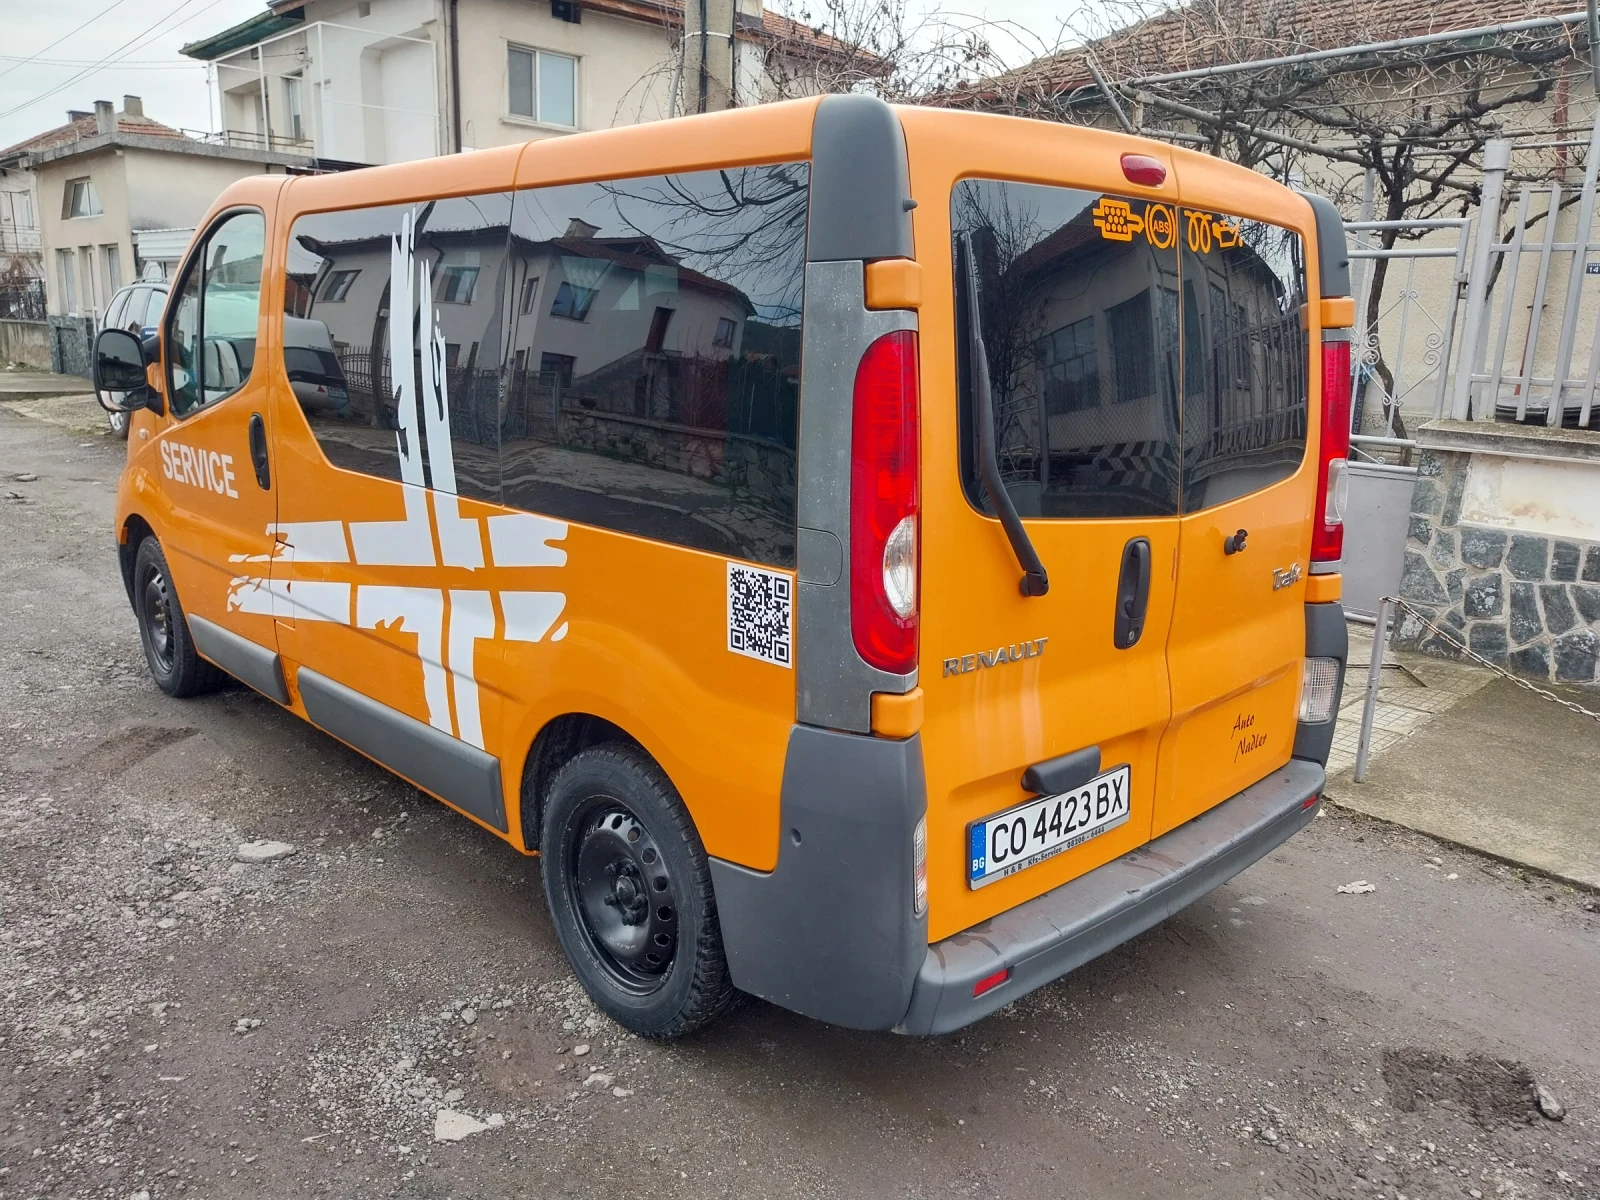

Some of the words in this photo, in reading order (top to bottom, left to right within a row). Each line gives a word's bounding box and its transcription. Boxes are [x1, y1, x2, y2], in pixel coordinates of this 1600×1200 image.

[1153, 220, 1169, 234] ABS
[160, 439, 239, 499] SERVICE
[942, 637, 1049, 678] RENAULT
[1230, 713, 1255, 740] Auto
[1233, 733, 1268, 764] Nadler
[991, 817, 1027, 864] CO
[1033, 790, 1091, 845] 4423
[1096, 775, 1124, 820] BX
[972, 857, 985, 872] BG
[1003, 867, 1009, 877] H
[1010, 865, 1017, 874] &
[1018, 863, 1023, 871] R
[1027, 847, 1062, 866] Kfz-Service
